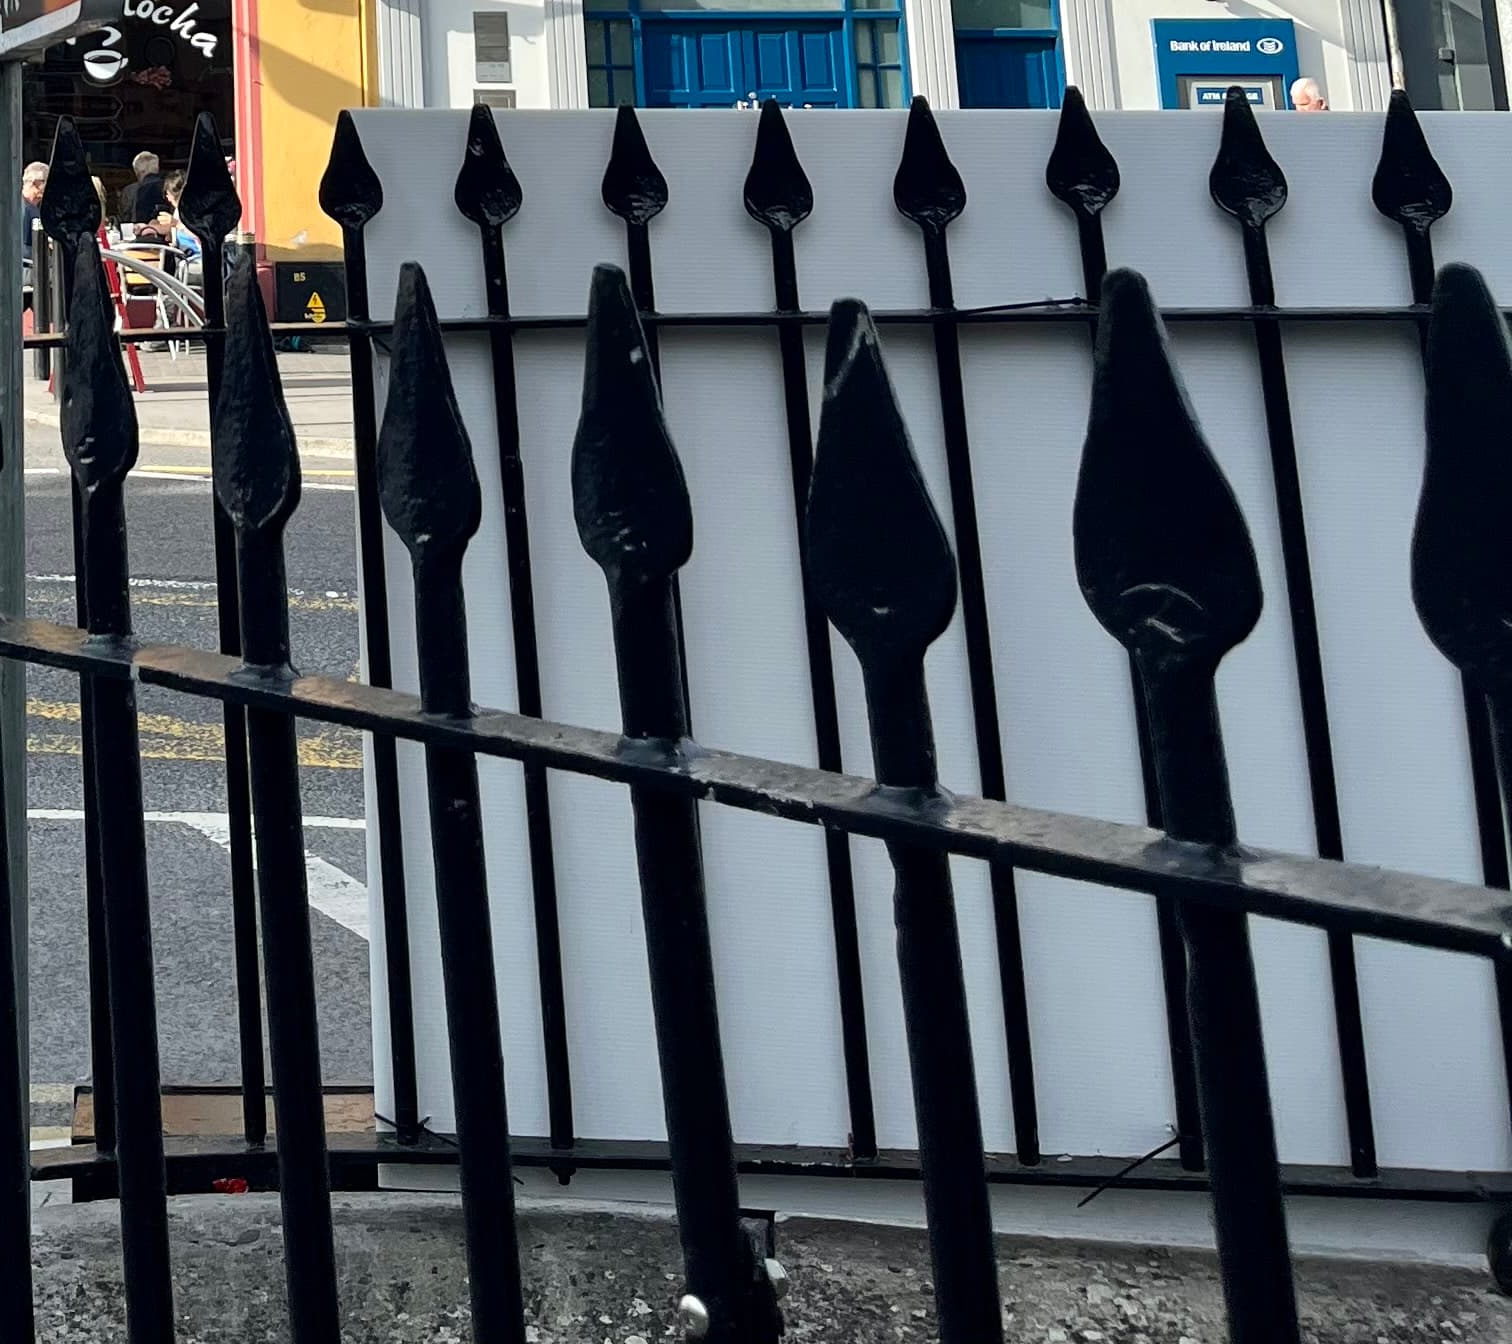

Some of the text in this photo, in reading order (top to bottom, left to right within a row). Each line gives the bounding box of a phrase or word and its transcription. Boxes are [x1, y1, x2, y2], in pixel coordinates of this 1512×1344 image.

[1170, 39, 1251, 52] Bank of Ireland
